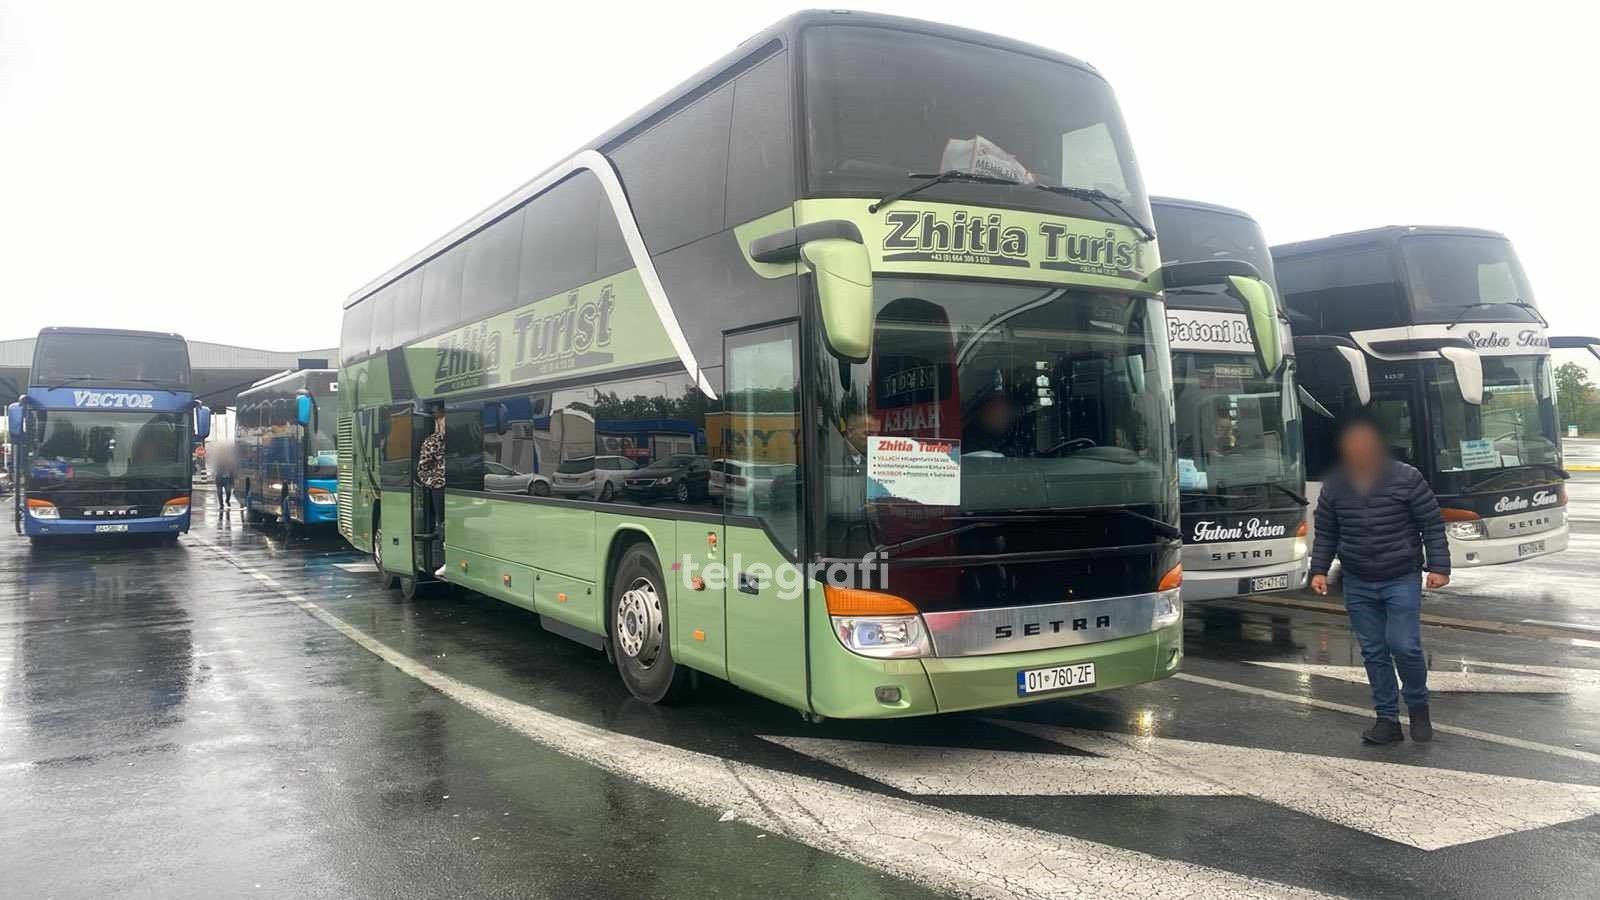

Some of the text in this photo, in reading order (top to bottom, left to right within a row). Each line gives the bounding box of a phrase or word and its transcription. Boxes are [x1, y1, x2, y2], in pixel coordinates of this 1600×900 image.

[883, 211, 1147, 272] Zhitia Turist
[513, 284, 615, 367] Turist
[1167, 317, 1231, 343] Fatoni
[73, 390, 154, 408] VECTOR
[878, 440, 913, 453] Zhitia
[1193, 517, 1286, 541] Fatoni Reisen
[1509, 517, 1550, 530] SETRA
[1212, 549, 1273, 561] SETRA
[995, 615, 1111, 639] SETRA
